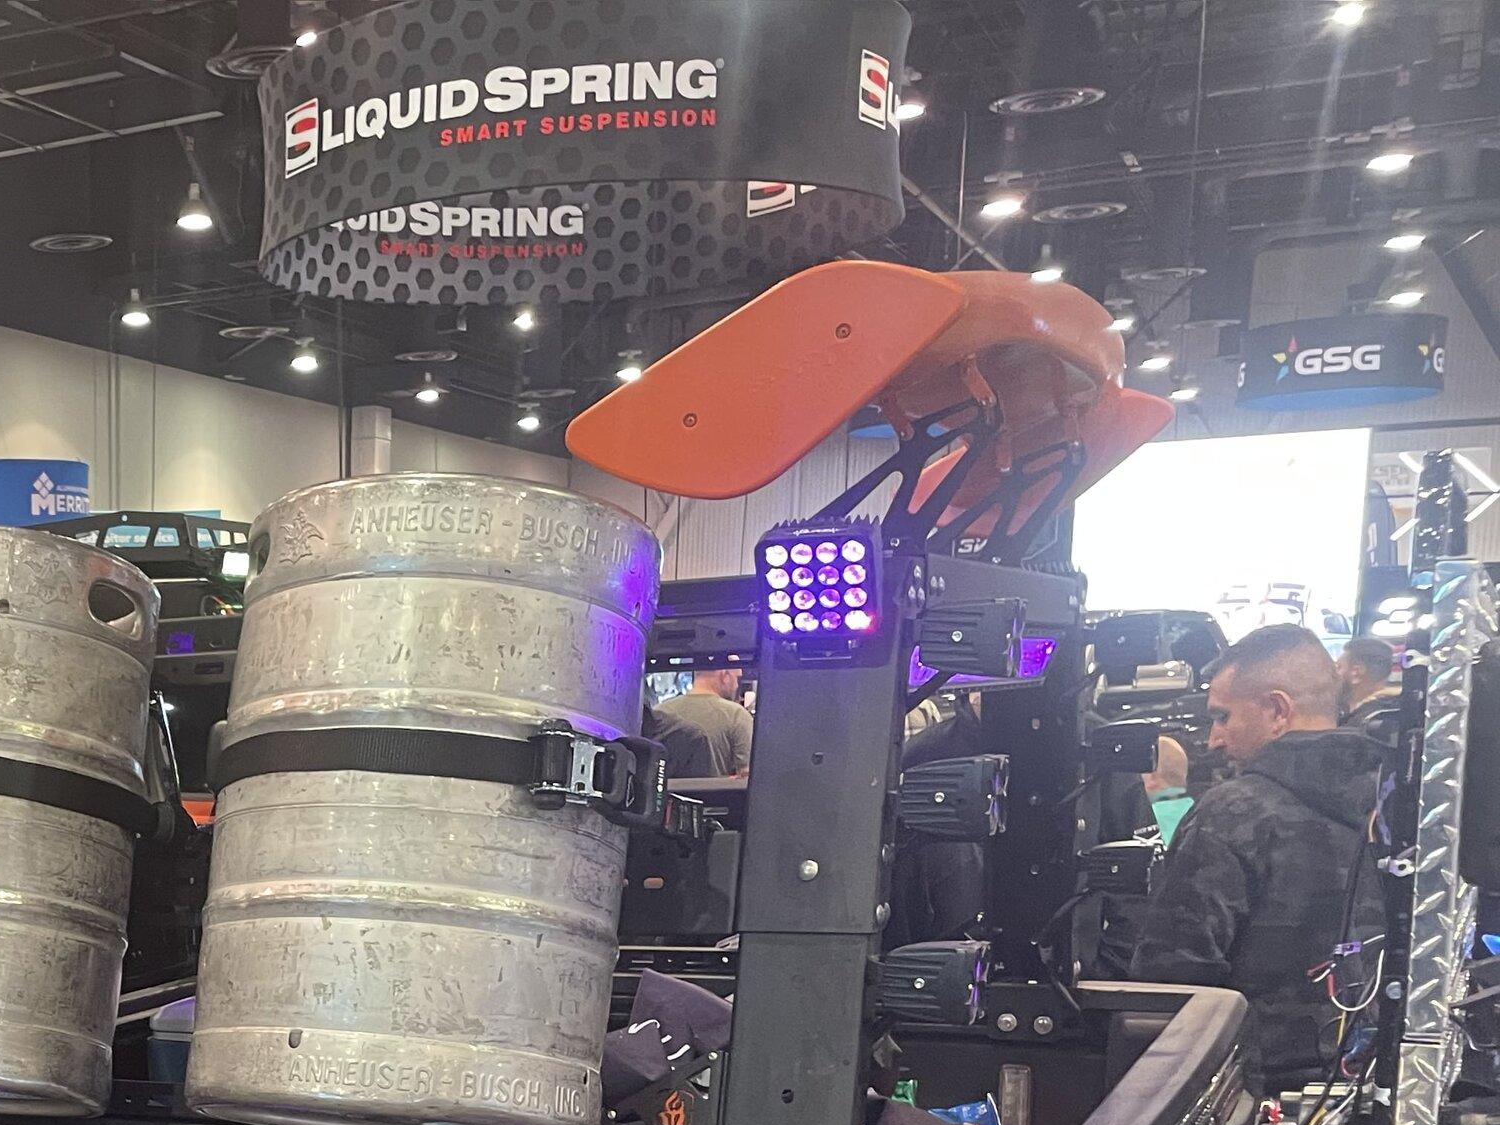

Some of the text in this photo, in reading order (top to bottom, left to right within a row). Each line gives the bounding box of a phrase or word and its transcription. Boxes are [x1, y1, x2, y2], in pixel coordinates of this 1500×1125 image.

[440, 108, 717, 147] SMART SUSPENSION
[379, 240, 584, 258] SMART SUSPENSION
[1294, 345, 1382, 375] GSG
[288, 1054, 433, 1094] ANHEUSER
